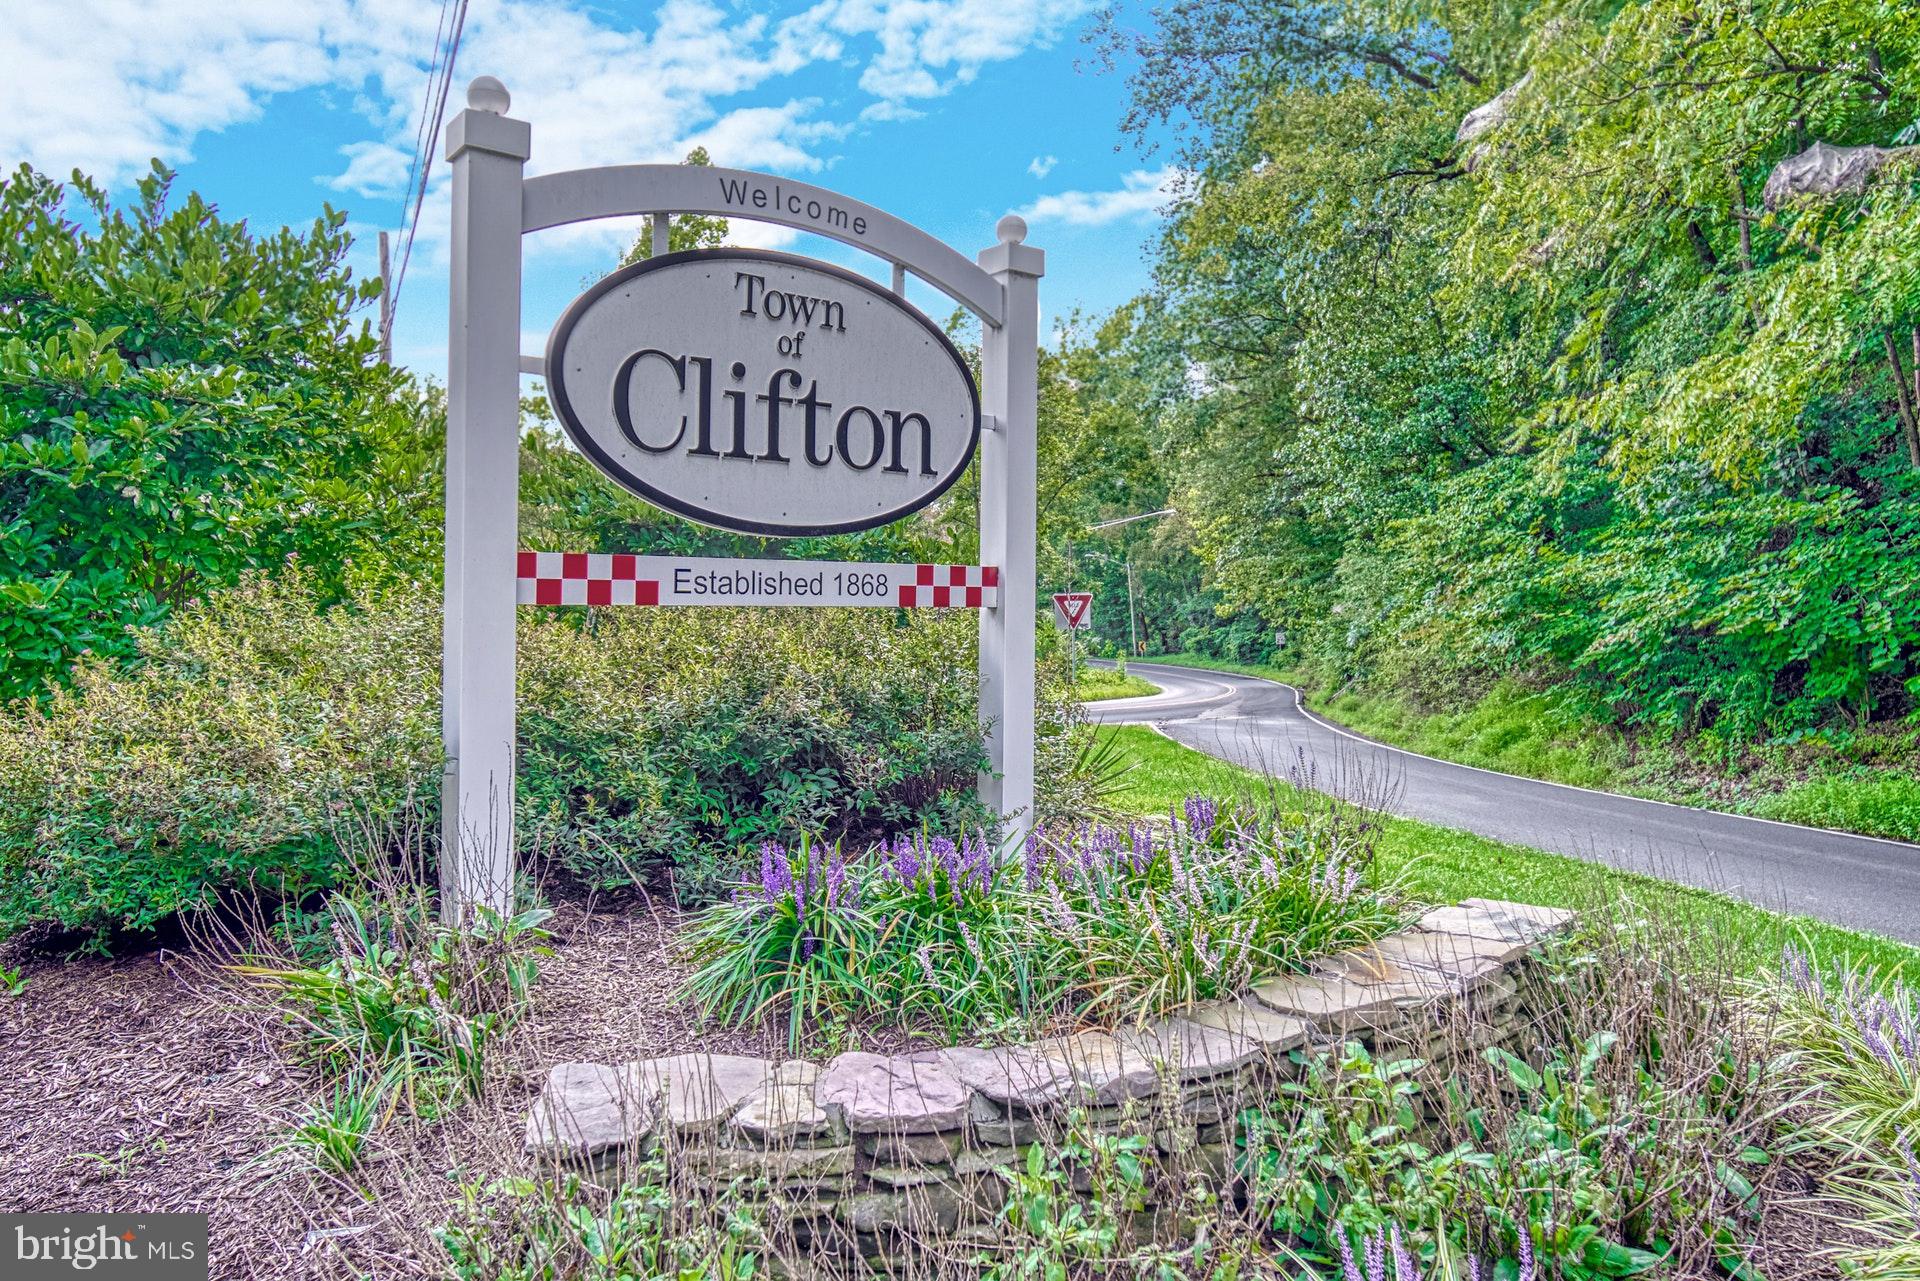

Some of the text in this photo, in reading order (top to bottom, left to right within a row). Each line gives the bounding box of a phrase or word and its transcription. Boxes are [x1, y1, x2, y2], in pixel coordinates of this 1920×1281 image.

[719, 177, 868, 236] Welcome
[735, 271, 847, 332] Town
[777, 331, 806, 358] of
[611, 348, 939, 477] Clifton
[673, 567, 889, 597] Established 1868
